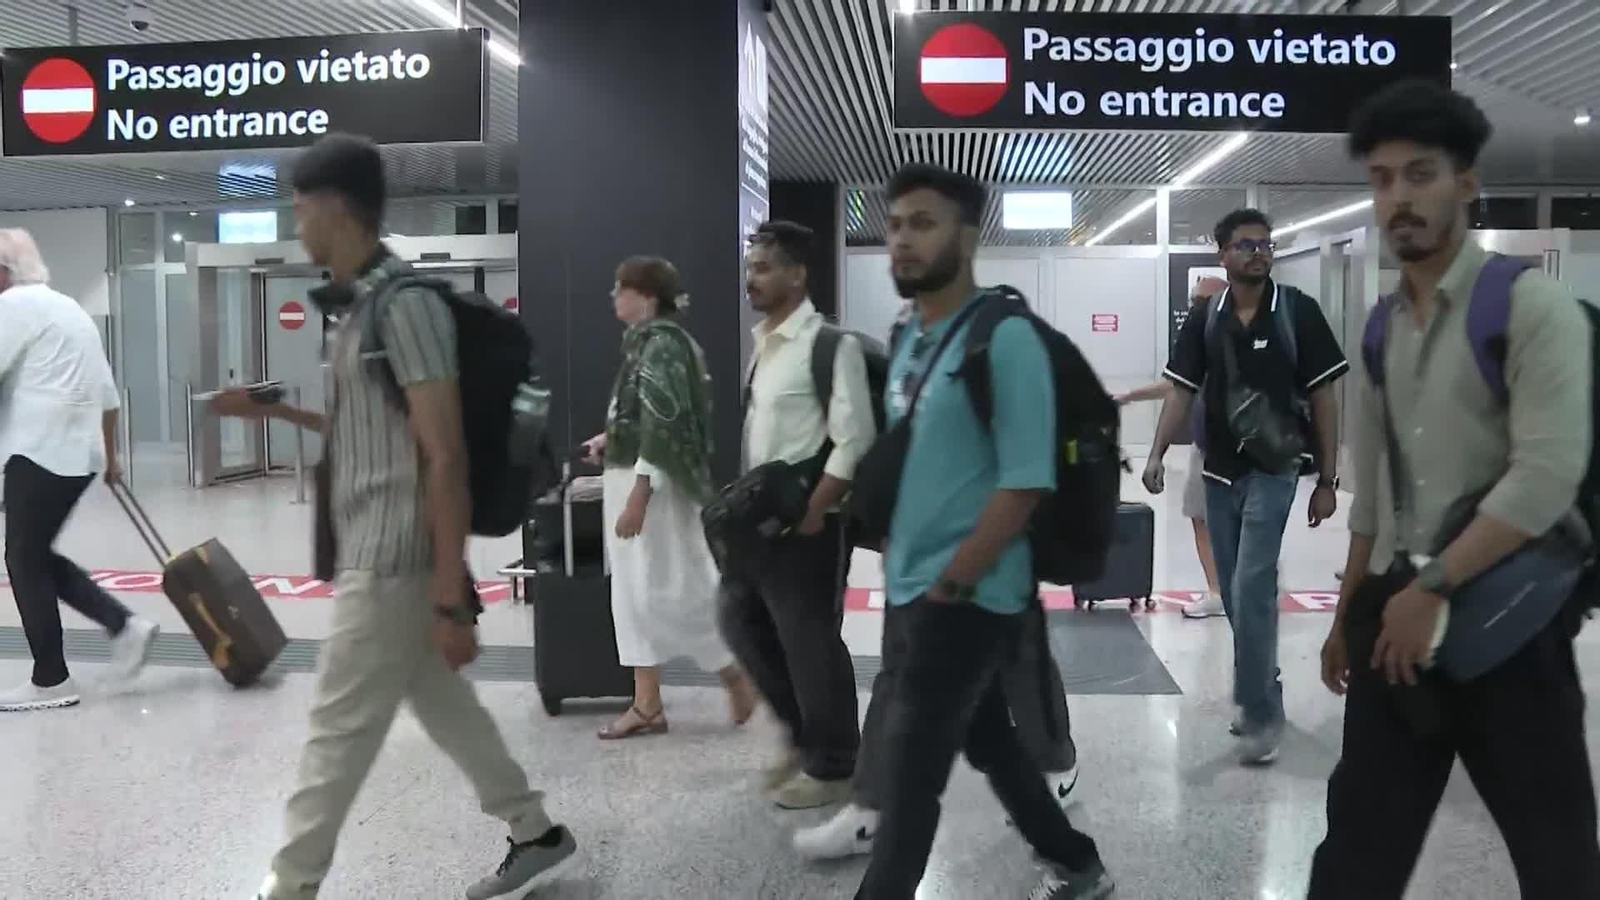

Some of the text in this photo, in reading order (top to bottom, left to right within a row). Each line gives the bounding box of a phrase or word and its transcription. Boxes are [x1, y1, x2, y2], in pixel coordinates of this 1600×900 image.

[1023, 28, 1396, 72] Passaggio vietato
[107, 49, 431, 96] Passaggio vietato
[1024, 81, 1285, 118] No entrance
[107, 107, 329, 141] No entrance
